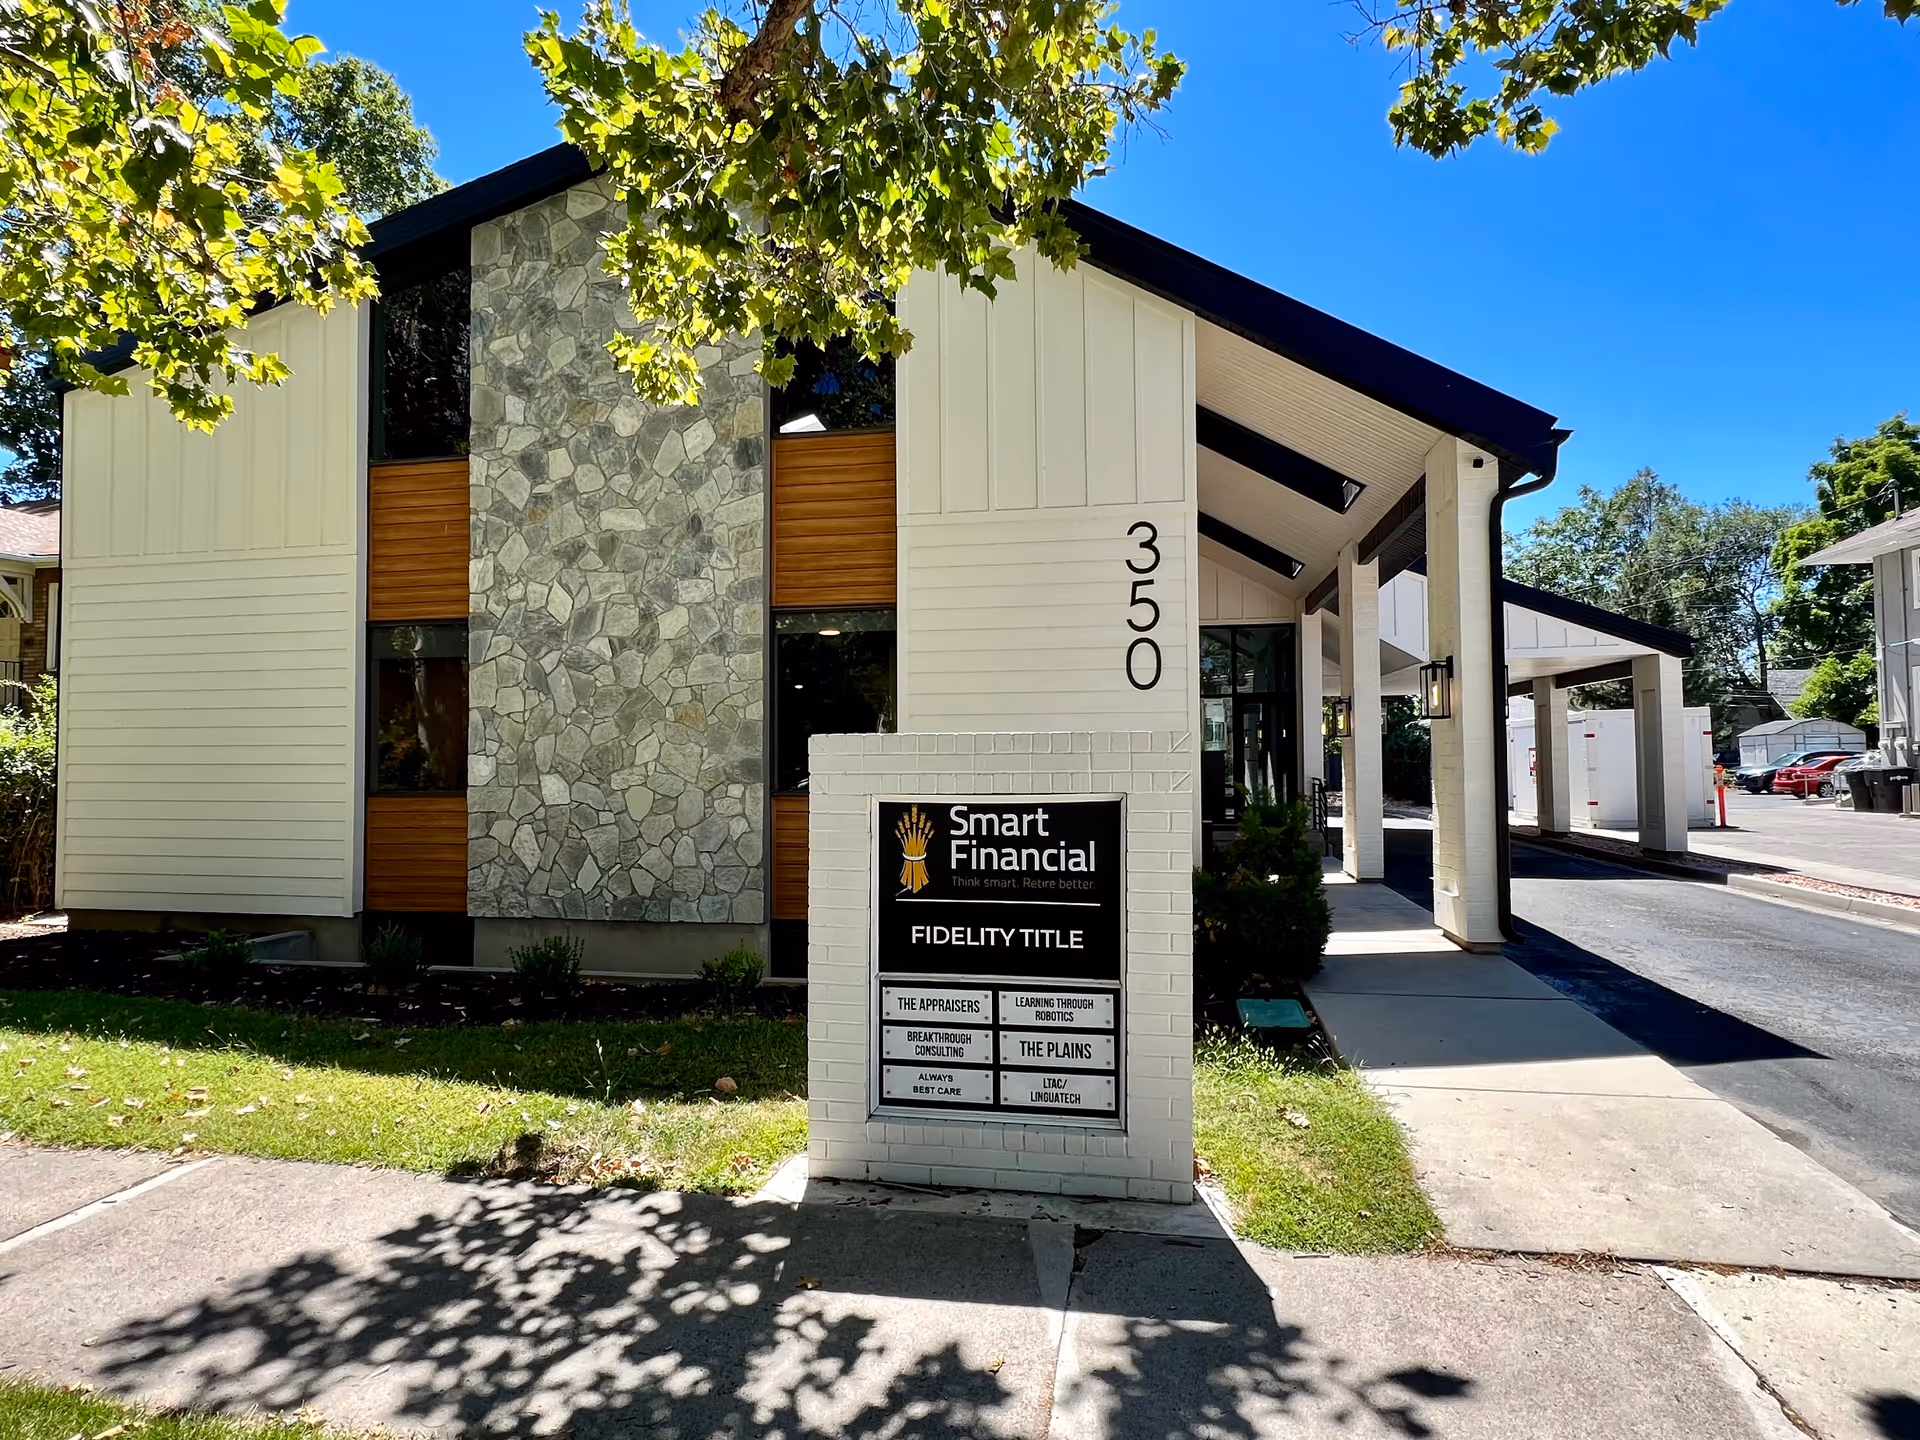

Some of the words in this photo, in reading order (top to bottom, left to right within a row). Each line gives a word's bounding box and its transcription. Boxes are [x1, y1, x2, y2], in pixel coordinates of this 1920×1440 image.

[1125, 521, 1162, 690] 350
[950, 805, 1049, 836] Smart
[951, 840, 1096, 872] Financial
[952, 876, 981, 887] Think
[983, 878, 1020, 888] smart.
[1023, 877, 1056, 889] Retire
[1059, 878, 1096, 890] better.
[912, 926, 1015, 947] FIDELITY
[1019, 929, 1084, 949] TITLE
[898, 997, 917, 1011] THE
[919, 998, 980, 1013] APPRAISERS
[1015, 997, 1054, 1008] LEARNING
[1056, 998, 1094, 1009] THROUGH
[1035, 1011, 1074, 1022] ROBOTICS
[907, 1031, 972, 1044] BREAKTHROUGH
[915, 1045, 964, 1058] CONSULTING
[1019, 1041, 1044, 1057] THE
[1047, 1042, 1092, 1059] PLAINS
[918, 1073, 954, 1082] ALWAYS
[1043, 1078, 1068, 1089] LTAC/
[913, 1086, 935, 1094] BEST
[937, 1087, 962, 1096] CARE
[1030, 1091, 1081, 1104] LINGUATECH
